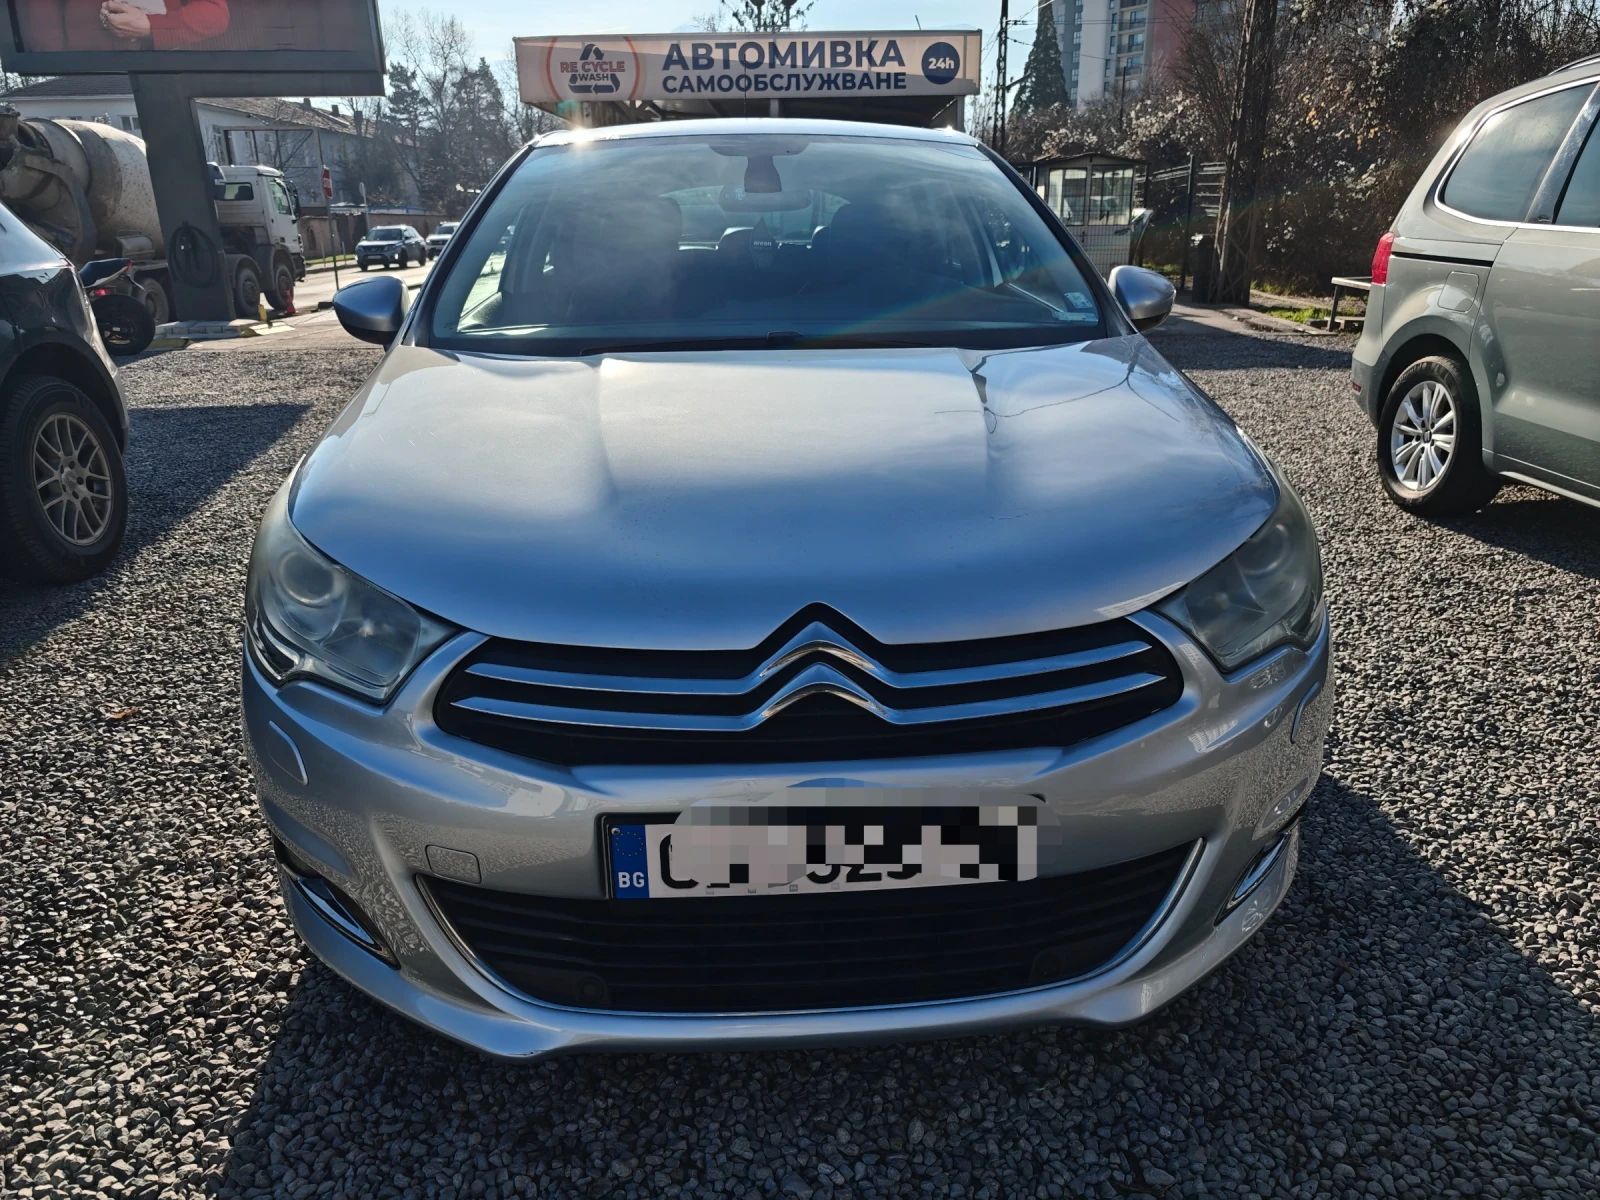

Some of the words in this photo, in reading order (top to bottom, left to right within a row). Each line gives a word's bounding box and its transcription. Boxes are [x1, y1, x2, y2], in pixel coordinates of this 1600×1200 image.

[662, 40, 906, 71] АВТОМИВКА
[560, 62, 579, 73] RE
[581, 61, 626, 73] CYCLE
[928, 57, 955, 70] 24h
[578, 73, 609, 81] WASH
[662, 72, 907, 93] САМООБСЛУЖВАНЕ
[618, 871, 645, 888] BG
